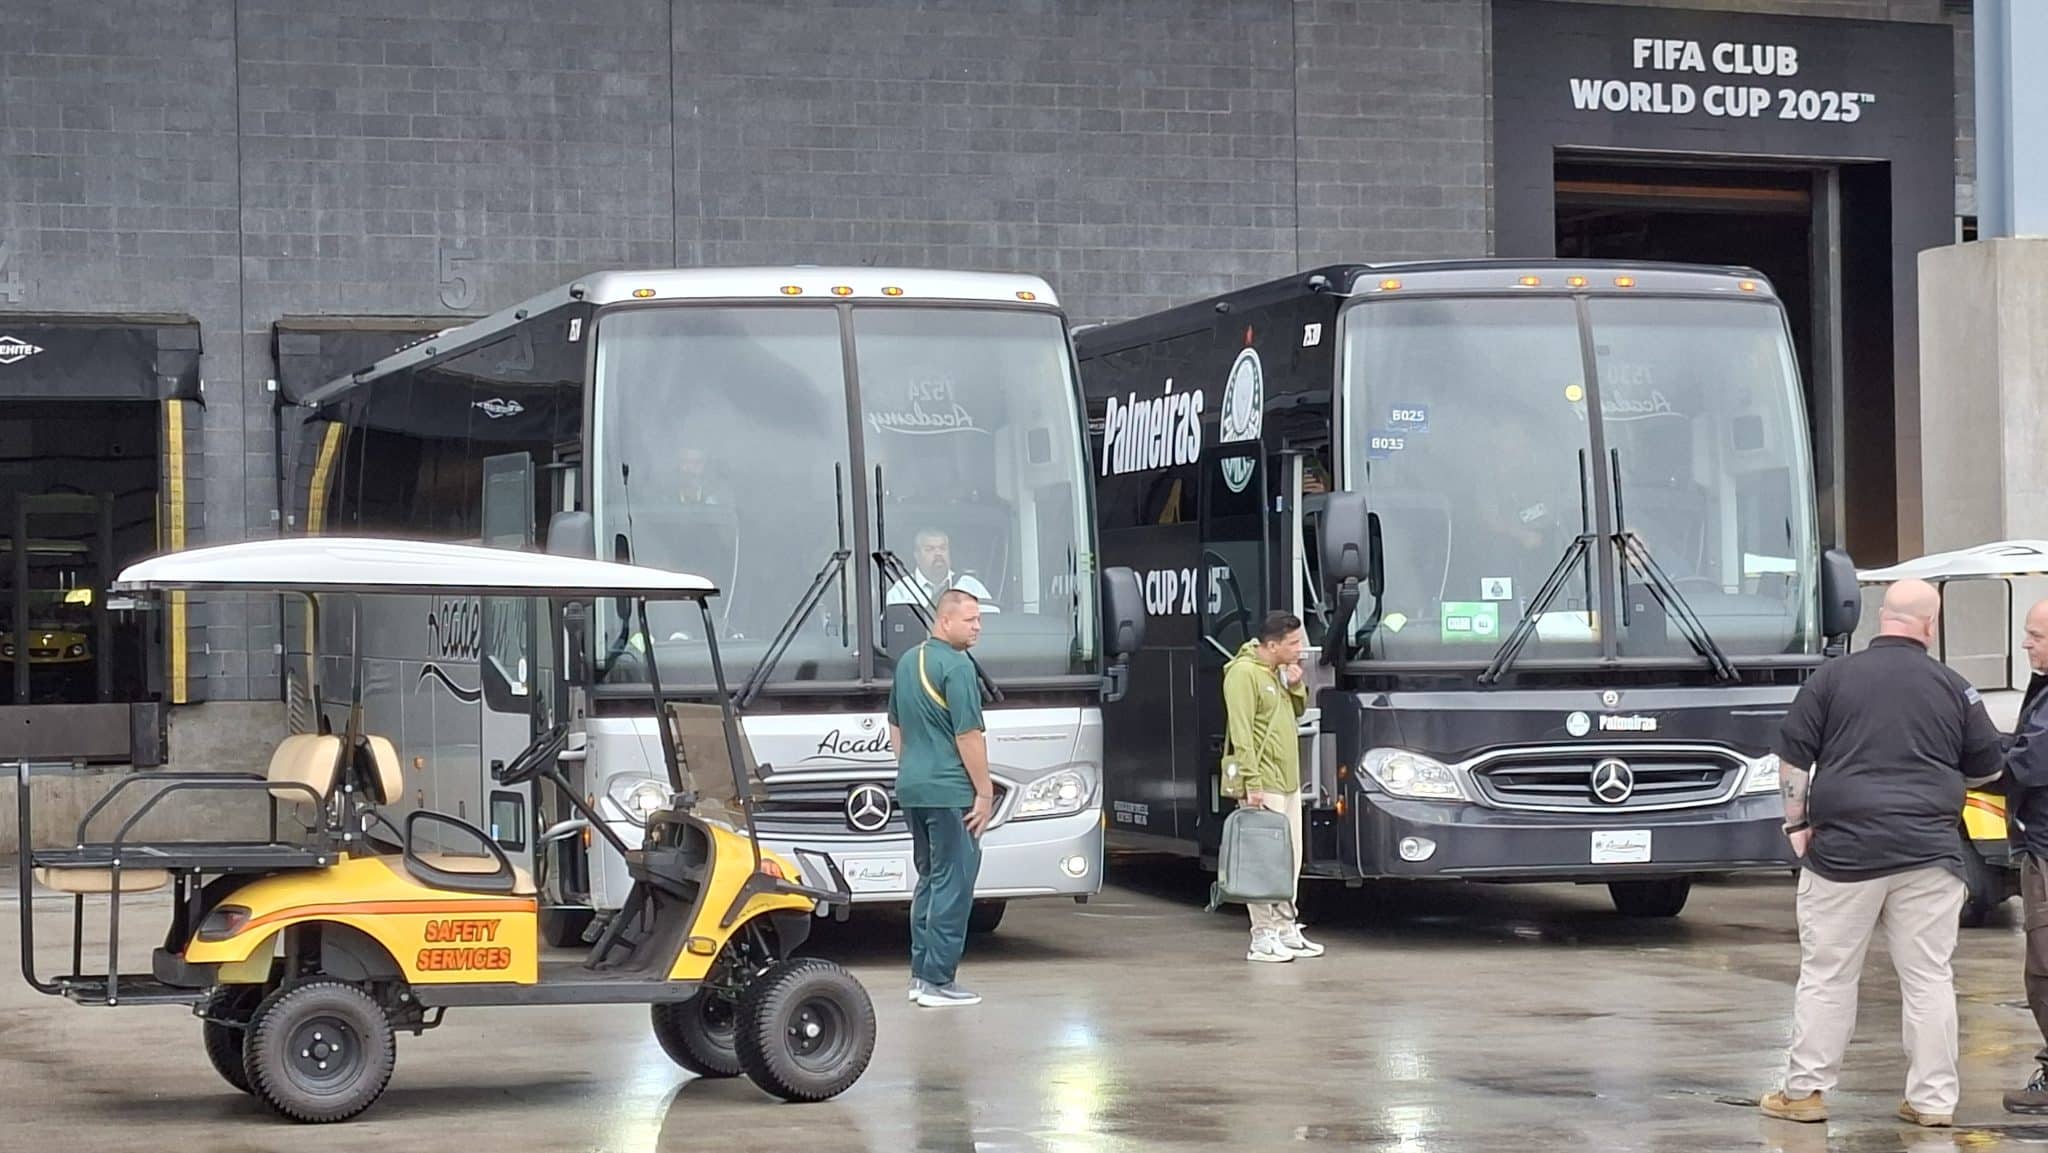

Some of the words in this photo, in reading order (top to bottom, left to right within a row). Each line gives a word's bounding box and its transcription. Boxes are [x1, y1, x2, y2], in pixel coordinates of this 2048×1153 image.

[1633, 38, 1706, 71] FIFA
[1712, 43, 1798, 76] CLUB
[1570, 79, 1695, 114] WORLD
[1703, 85, 1771, 117] CUP
[439, 246, 476, 310] 5
[1101, 378, 1204, 477] Palmeiras
[1145, 569, 1178, 616] CUP
[424, 919, 501, 942] SAFETY
[416, 947, 511, 971] SERVICES
